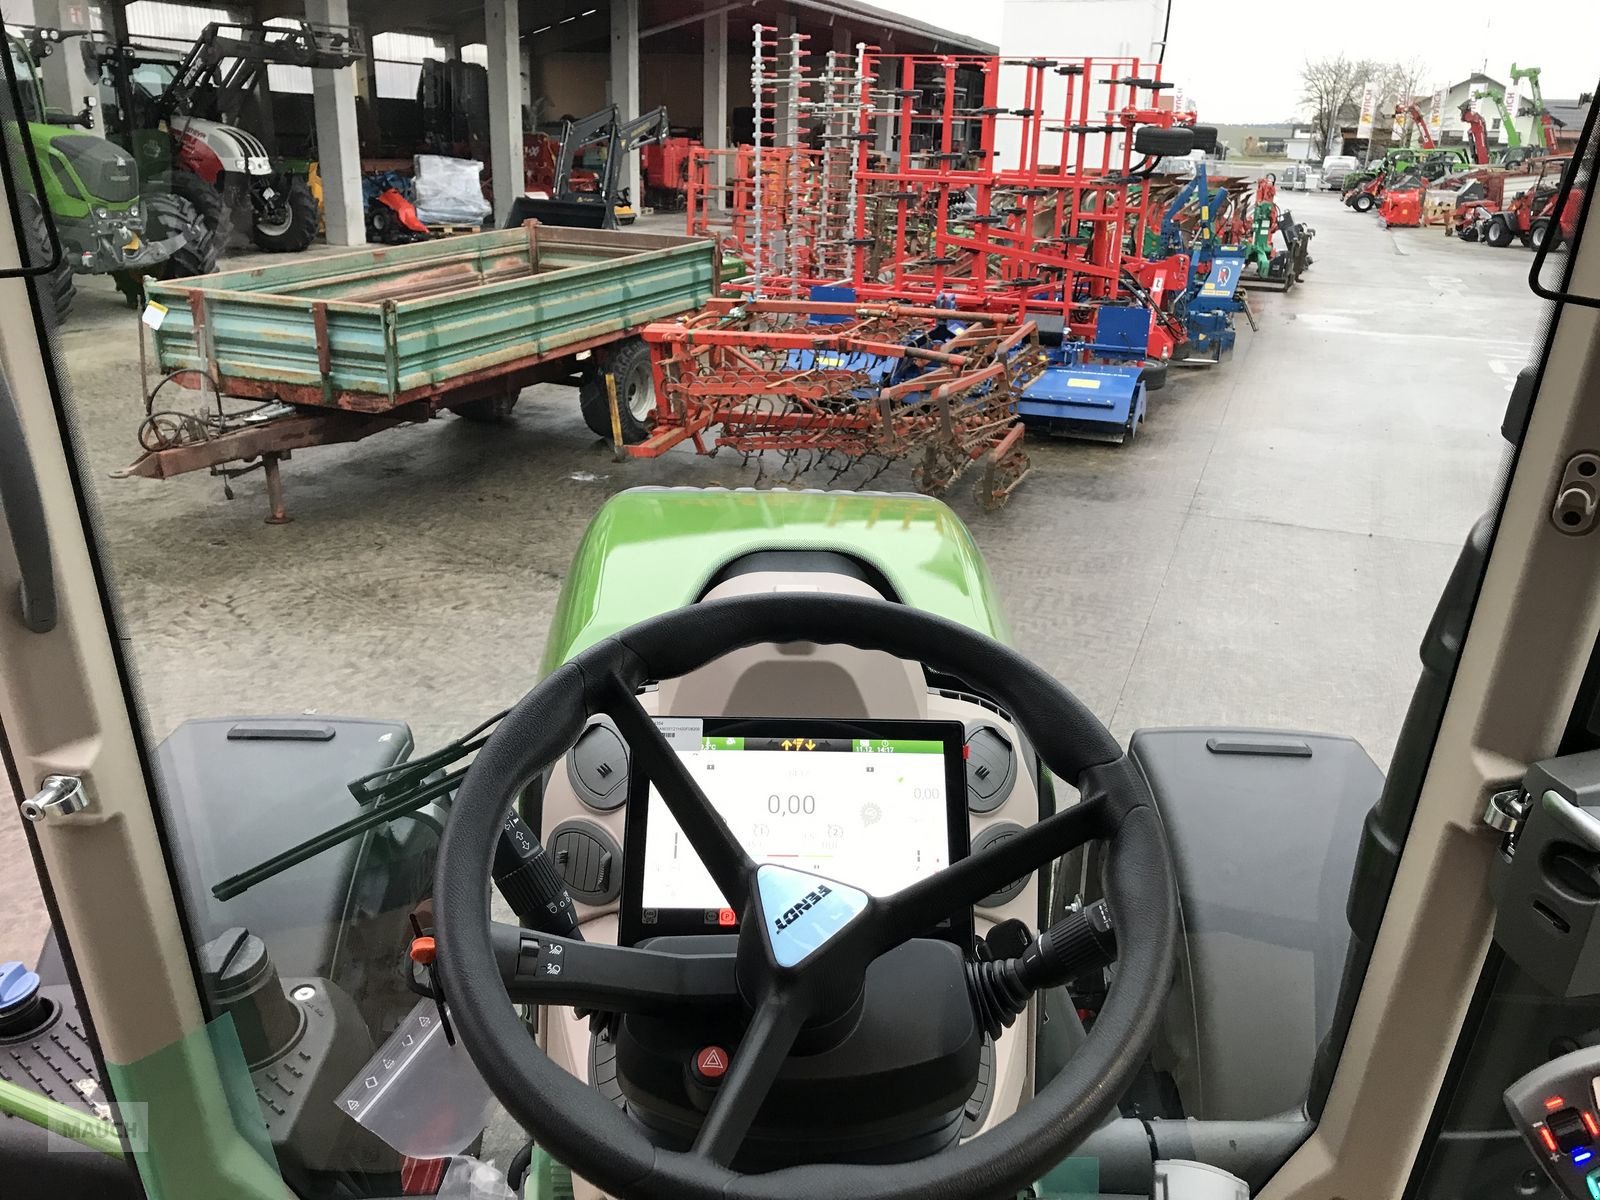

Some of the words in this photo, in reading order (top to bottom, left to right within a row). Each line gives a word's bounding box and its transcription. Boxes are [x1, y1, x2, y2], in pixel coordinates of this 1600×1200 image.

[768, 794, 815, 817] 0,00
[913, 787, 940, 801] 0,00
[774, 884, 832, 935] FENDT
